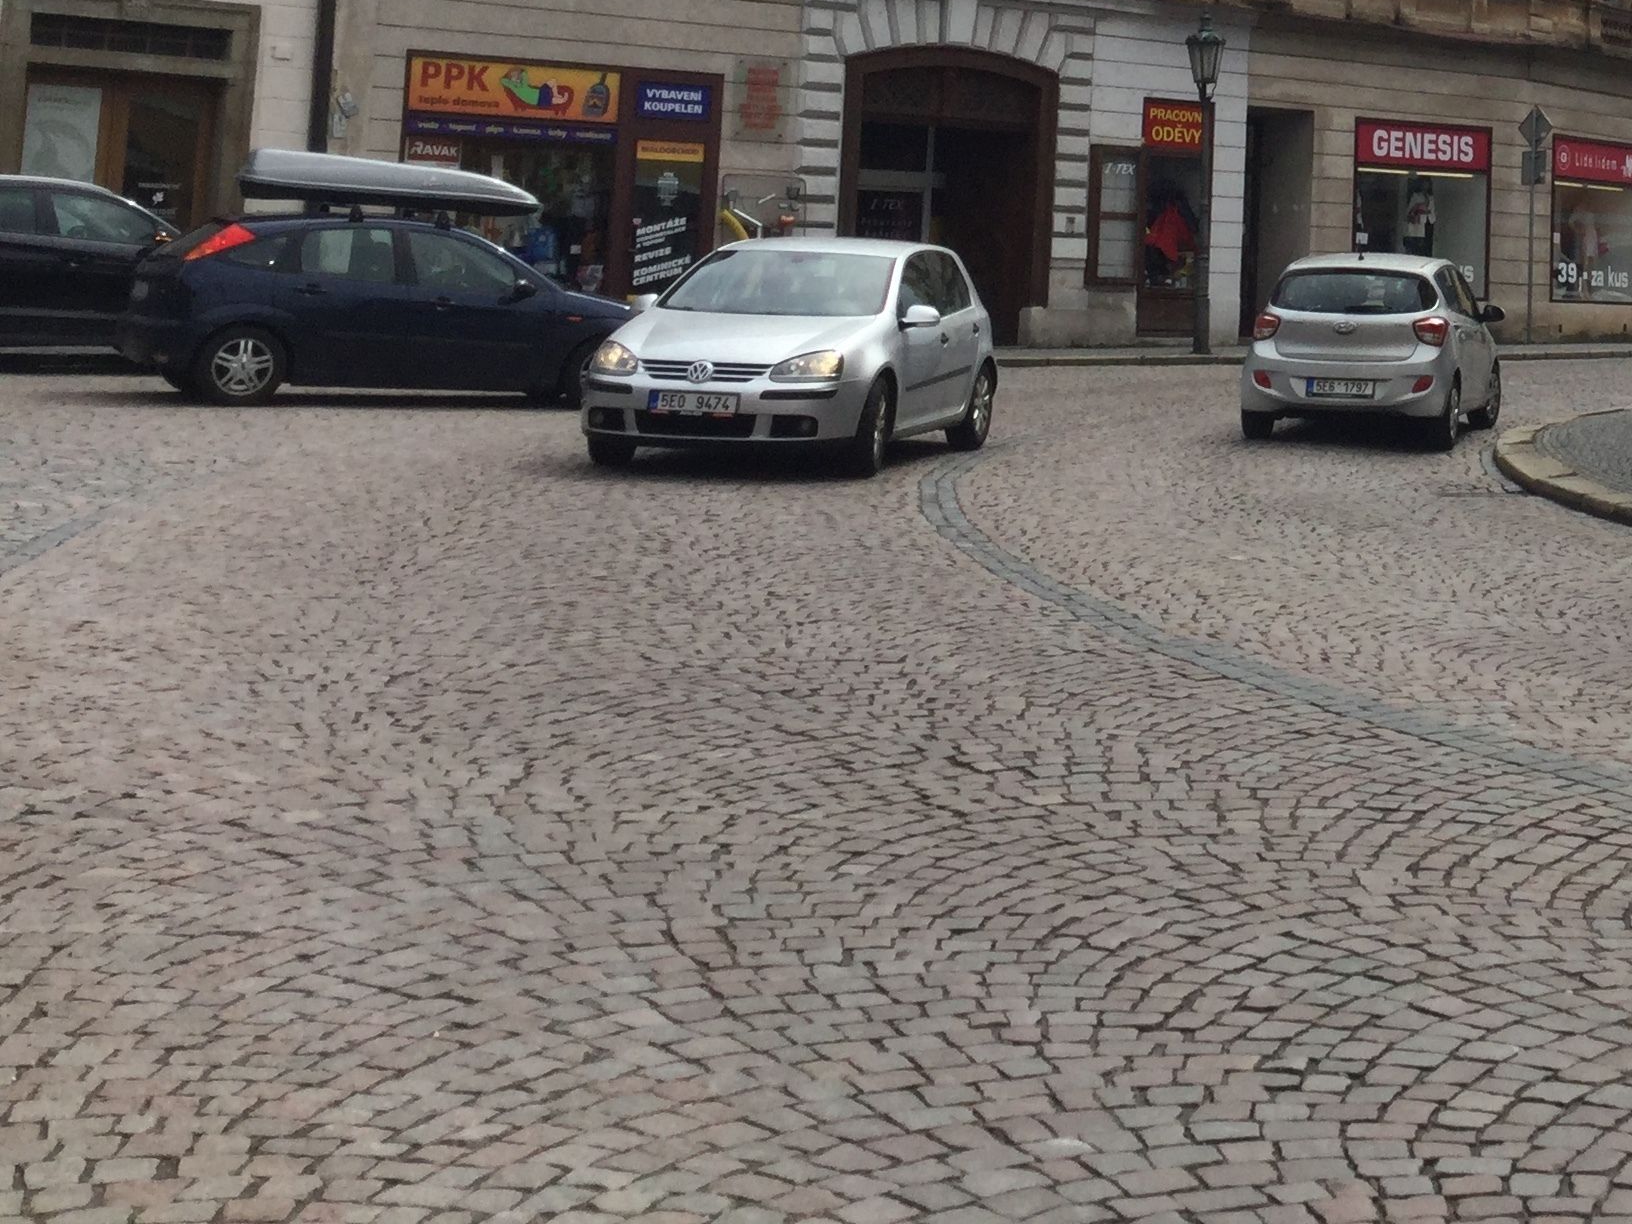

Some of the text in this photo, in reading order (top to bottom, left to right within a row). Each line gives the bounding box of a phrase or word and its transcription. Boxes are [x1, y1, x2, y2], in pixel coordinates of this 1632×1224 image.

[419, 61, 490, 91] PPK
[646, 88, 702, 101] VYBAVENÍ
[643, 101, 703, 114] KOUPELEN
[1149, 107, 1202, 123] PRACOVN
[1152, 123, 1202, 144] ODĚVY
[410, 141, 458, 158] RAVAK
[1372, 129, 1474, 162] GENESIS
[634, 246, 672, 263] REVIZE
[632, 267, 682, 286] CENTRUM
[1591, 270, 1604, 287] za
[1607, 265, 1629, 288] kus
[1343, 382, 1369, 394] 1797
[696, 393, 730, 411] 9474
